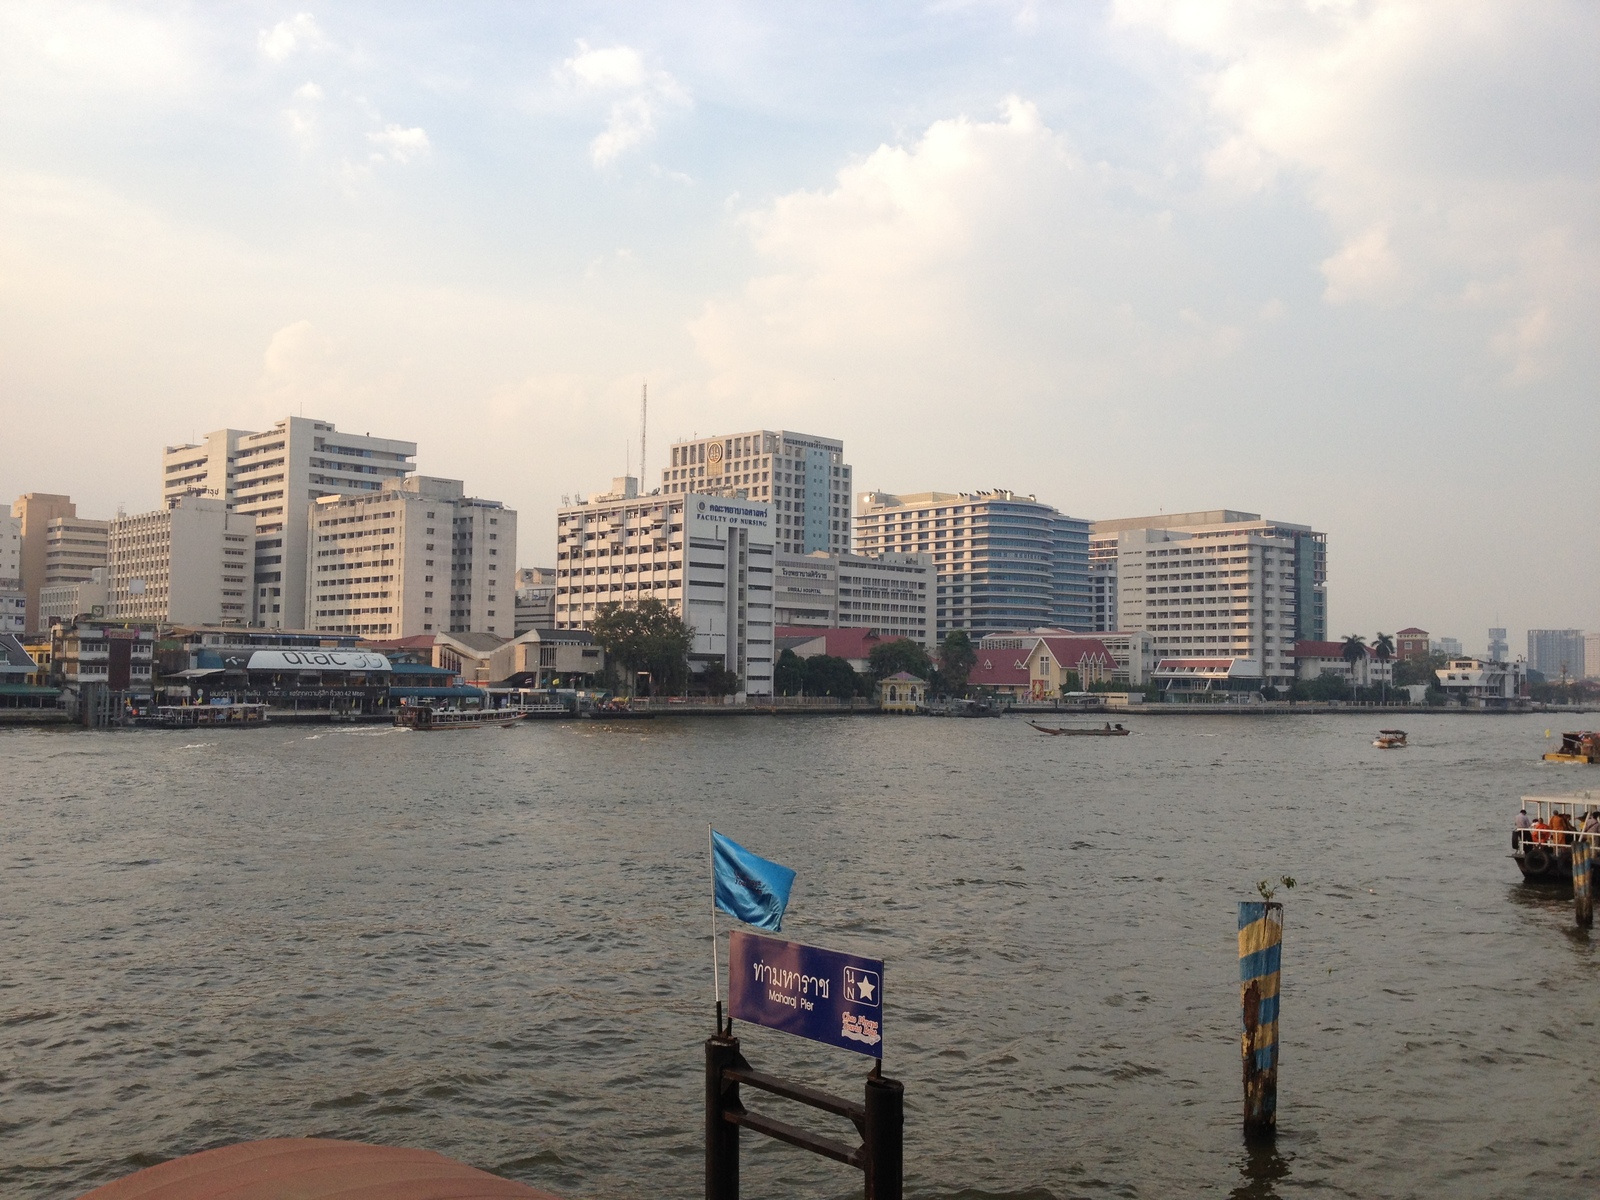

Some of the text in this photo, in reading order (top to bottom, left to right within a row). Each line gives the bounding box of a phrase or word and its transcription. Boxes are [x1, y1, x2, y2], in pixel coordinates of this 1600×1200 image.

[697, 514, 727, 522] FACULTY
[740, 519, 767, 527] NURSING
[282, 650, 383, 669] dtac 3G
[753, 959, 830, 999] ท่ามหาราช
[846, 970, 855, 984] น
[769, 989, 815, 1011] Maharaj Pier
[847, 987, 855, 1000] N
